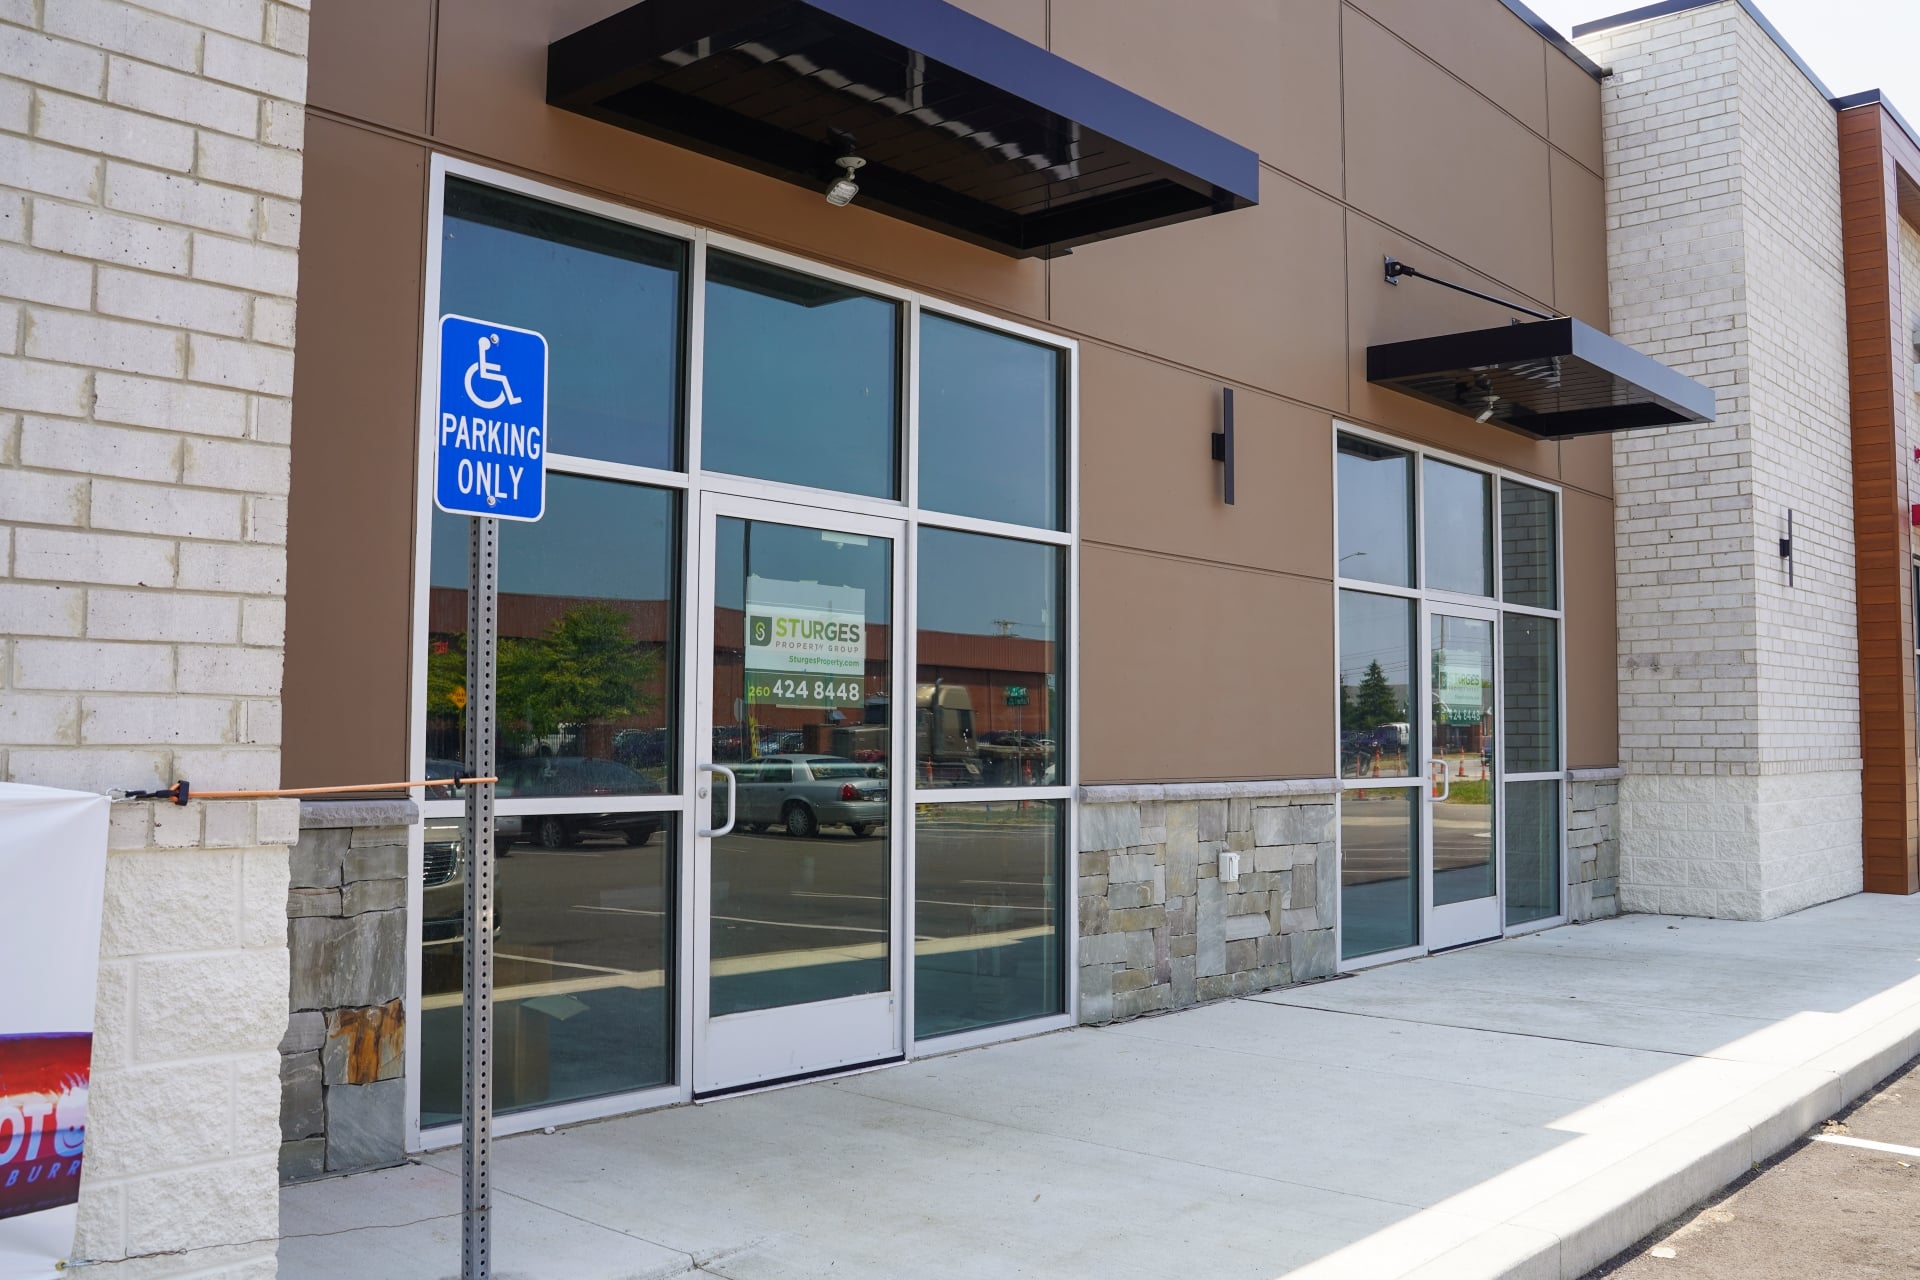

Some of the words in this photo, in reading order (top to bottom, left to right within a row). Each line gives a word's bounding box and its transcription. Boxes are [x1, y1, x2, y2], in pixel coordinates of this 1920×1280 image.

[442, 413, 541, 460] PARKING
[457, 458, 524, 500] ONLY
[775, 617, 861, 643] STURGES
[775, 641, 824, 651] PROPERTY
[828, 645, 859, 653] GROUP
[788, 656, 860, 667] SturgesProperty.com
[748, 685, 771, 697] 260
[772, 678, 809, 699] 424
[813, 680, 860, 701] 8448
